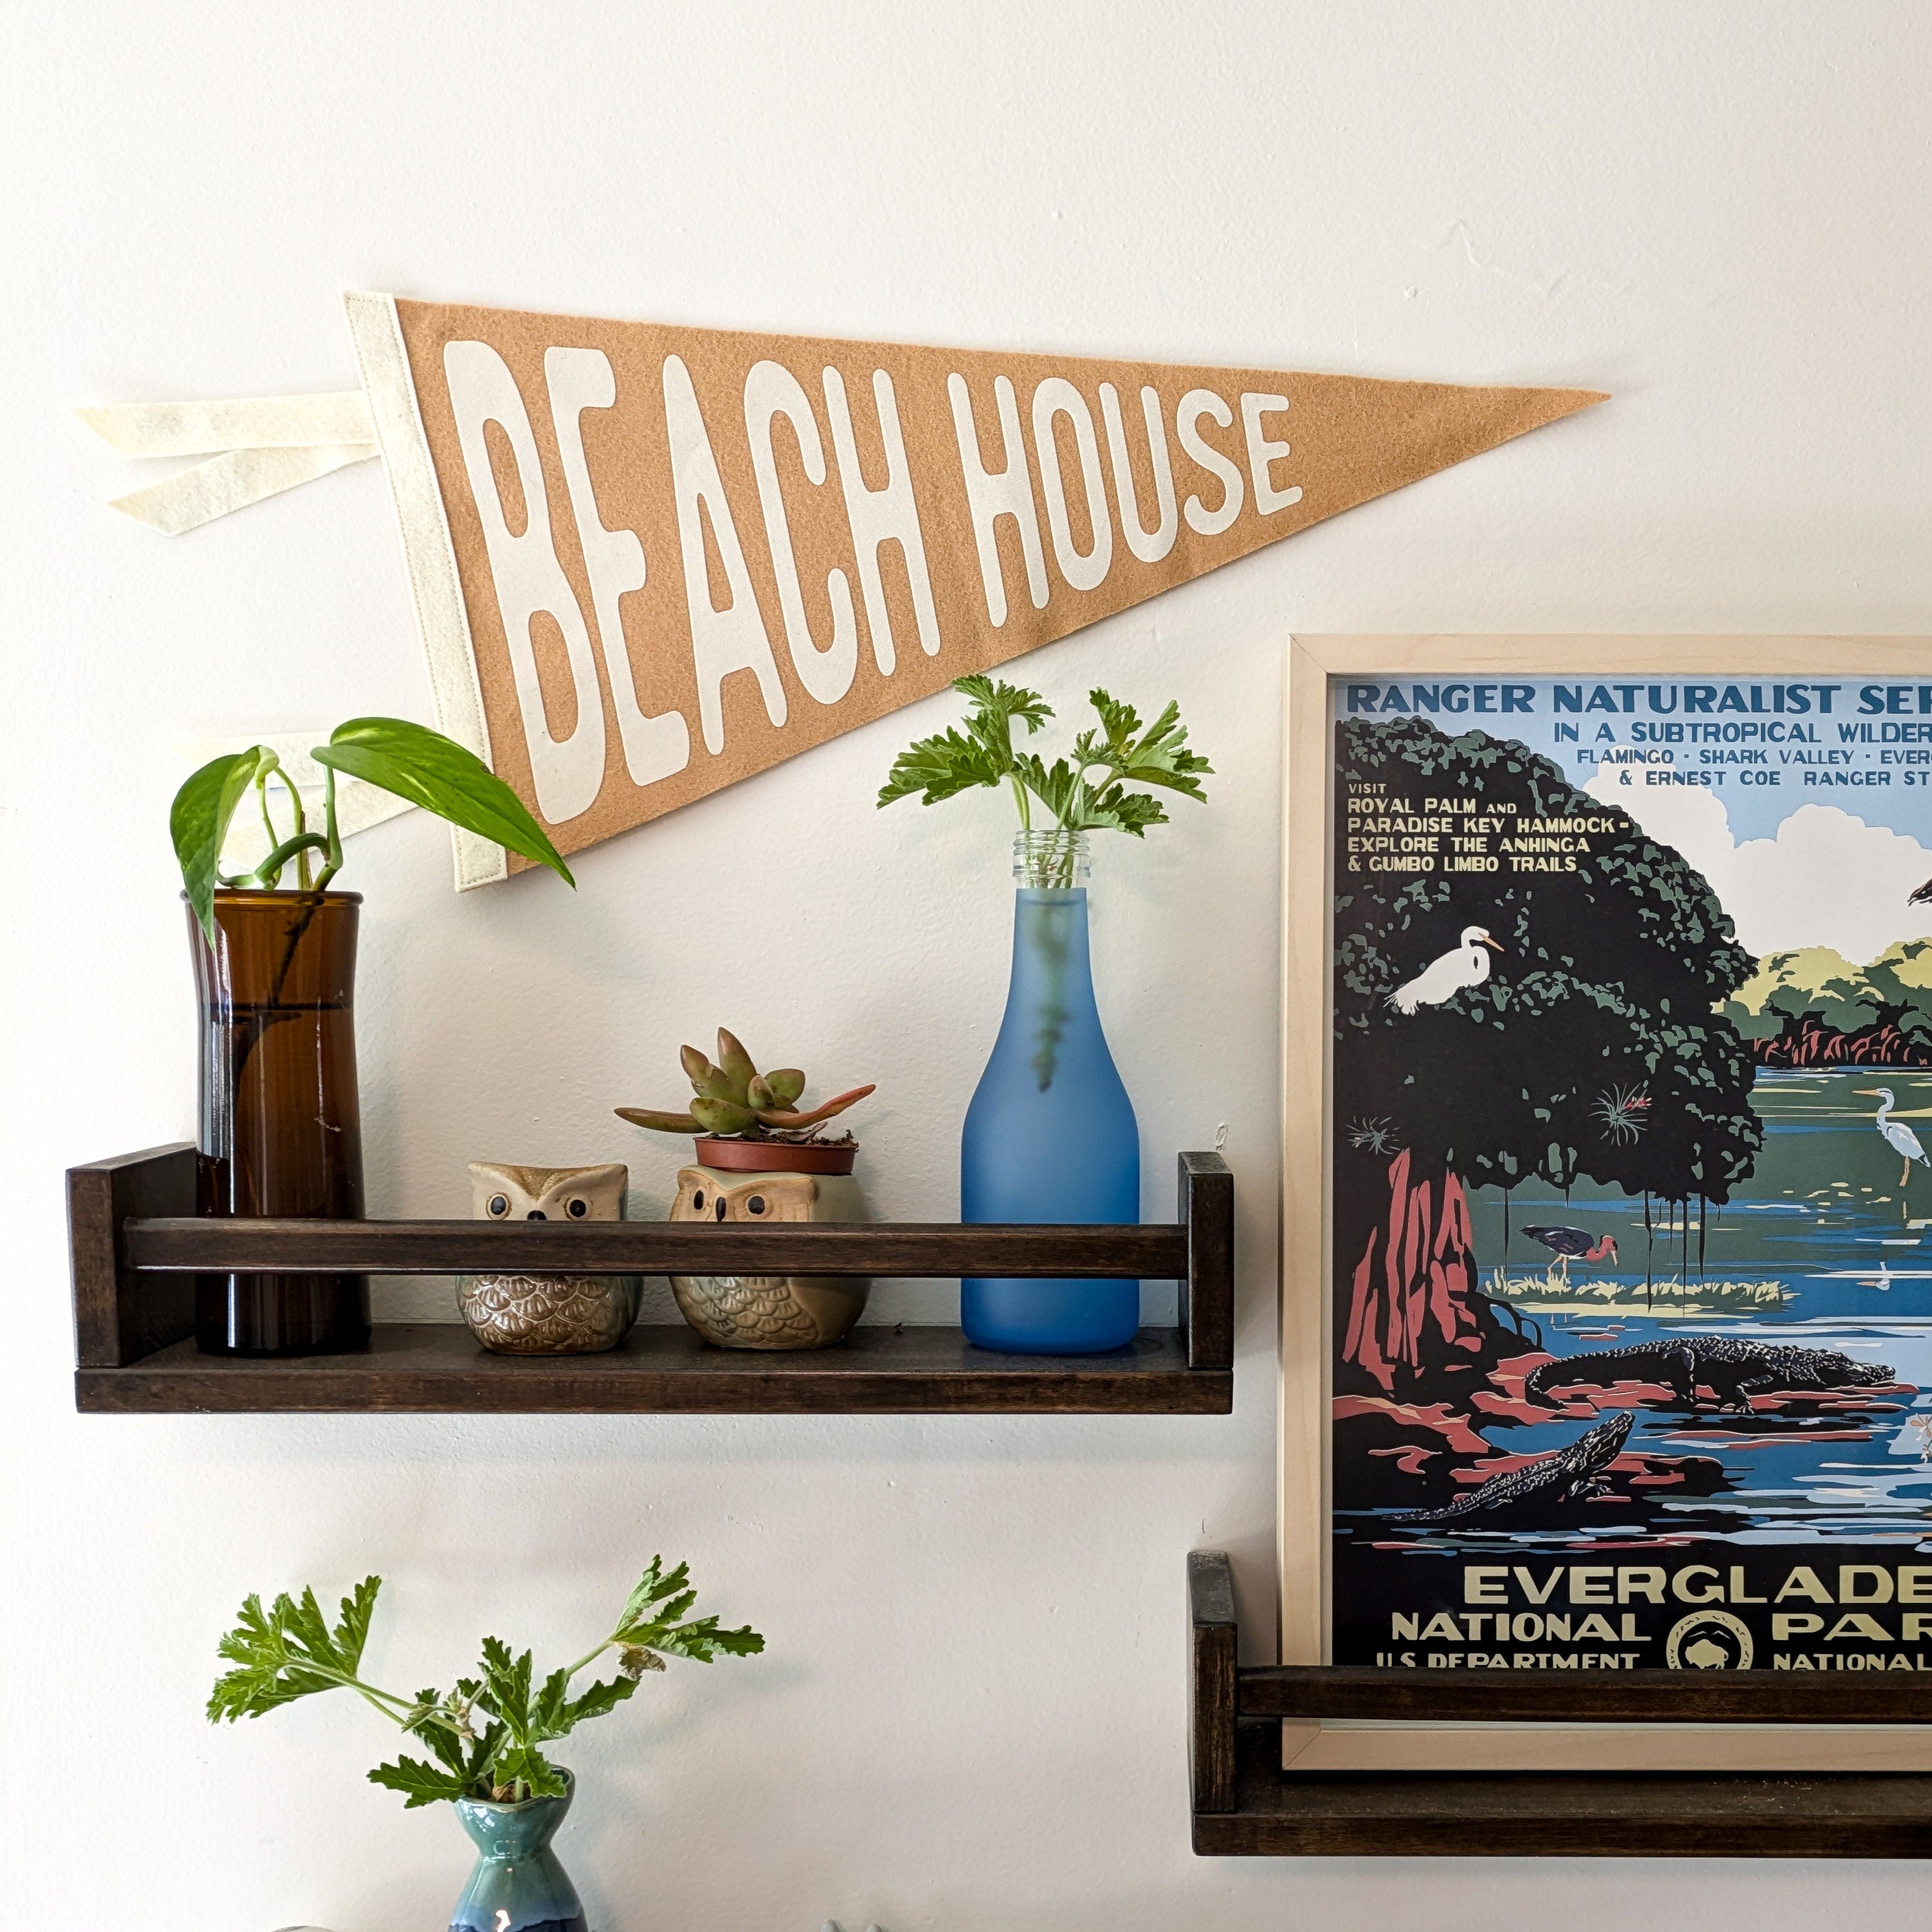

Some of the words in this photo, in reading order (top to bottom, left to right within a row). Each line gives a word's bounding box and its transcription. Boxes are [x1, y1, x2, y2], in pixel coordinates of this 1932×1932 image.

[444, 340, 939, 825] BEACH
[947, 372, 1303, 628] HOUSE
[1348, 684, 1535, 712] RANGER
[1554, 685, 1841, 714] NATURALIST
[1554, 723, 1579, 742] IN
[1595, 723, 1615, 742] A
[1632, 721, 1822, 743] SUBTROPICAL
[1578, 750, 1673, 763] FLAMINGO
[1700, 750, 1768, 763] SHARK
[1779, 750, 1854, 764] VALLEY
[1881, 750, 1932, 764] EVER
[1620, 770, 1632, 785] &
[1646, 771, 1726, 785] ERNEST
[1740, 770, 1780, 785] COE
[1804, 771, 1891, 786] RANGER
[1349, 783, 1386, 793] VISIT
[1348, 798, 1414, 812] ROYAL
[1425, 799, 1476, 813] PALM
[1486, 803, 1516, 813] AND
[1348, 817, 1452, 832] PARADISE
[1464, 818, 1505, 832] KEY
[1348, 837, 1438, 852] EXPLORE
[1451, 837, 1487, 852] THE
[1499, 837, 1590, 852] ANHINGA
[1348, 855, 1360, 871] &
[1369, 857, 1434, 871] GUMBO
[1445, 857, 1499, 871] LIMBO
[1509, 857, 1576, 871] TRAILS
[1392, 1612, 1651, 1641] NATIONAL
[1774, 1654, 1932, 1670] NATIONAL
